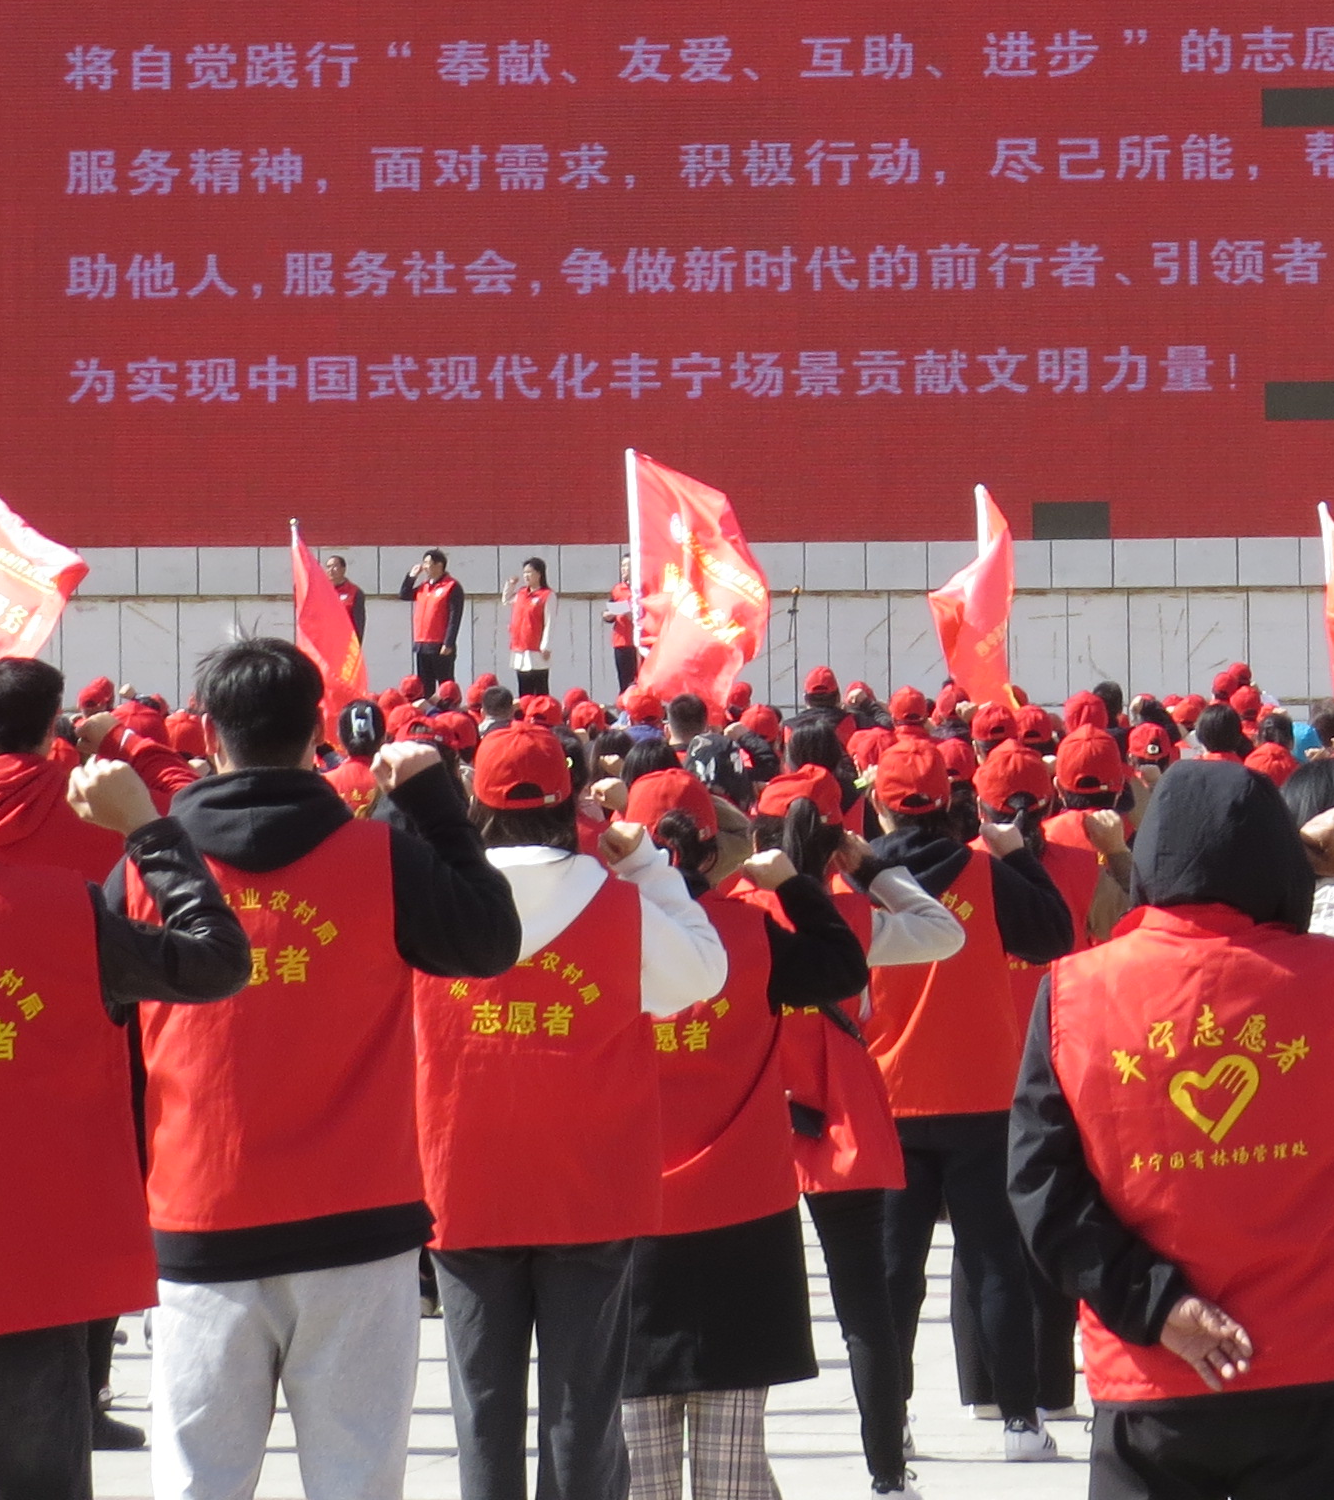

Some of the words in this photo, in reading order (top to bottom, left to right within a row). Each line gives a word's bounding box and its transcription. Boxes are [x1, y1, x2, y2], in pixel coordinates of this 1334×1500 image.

[471, 999, 574, 1037] 志愿者
[1111, 1004, 1311, 1084] 丰宁志愿者
